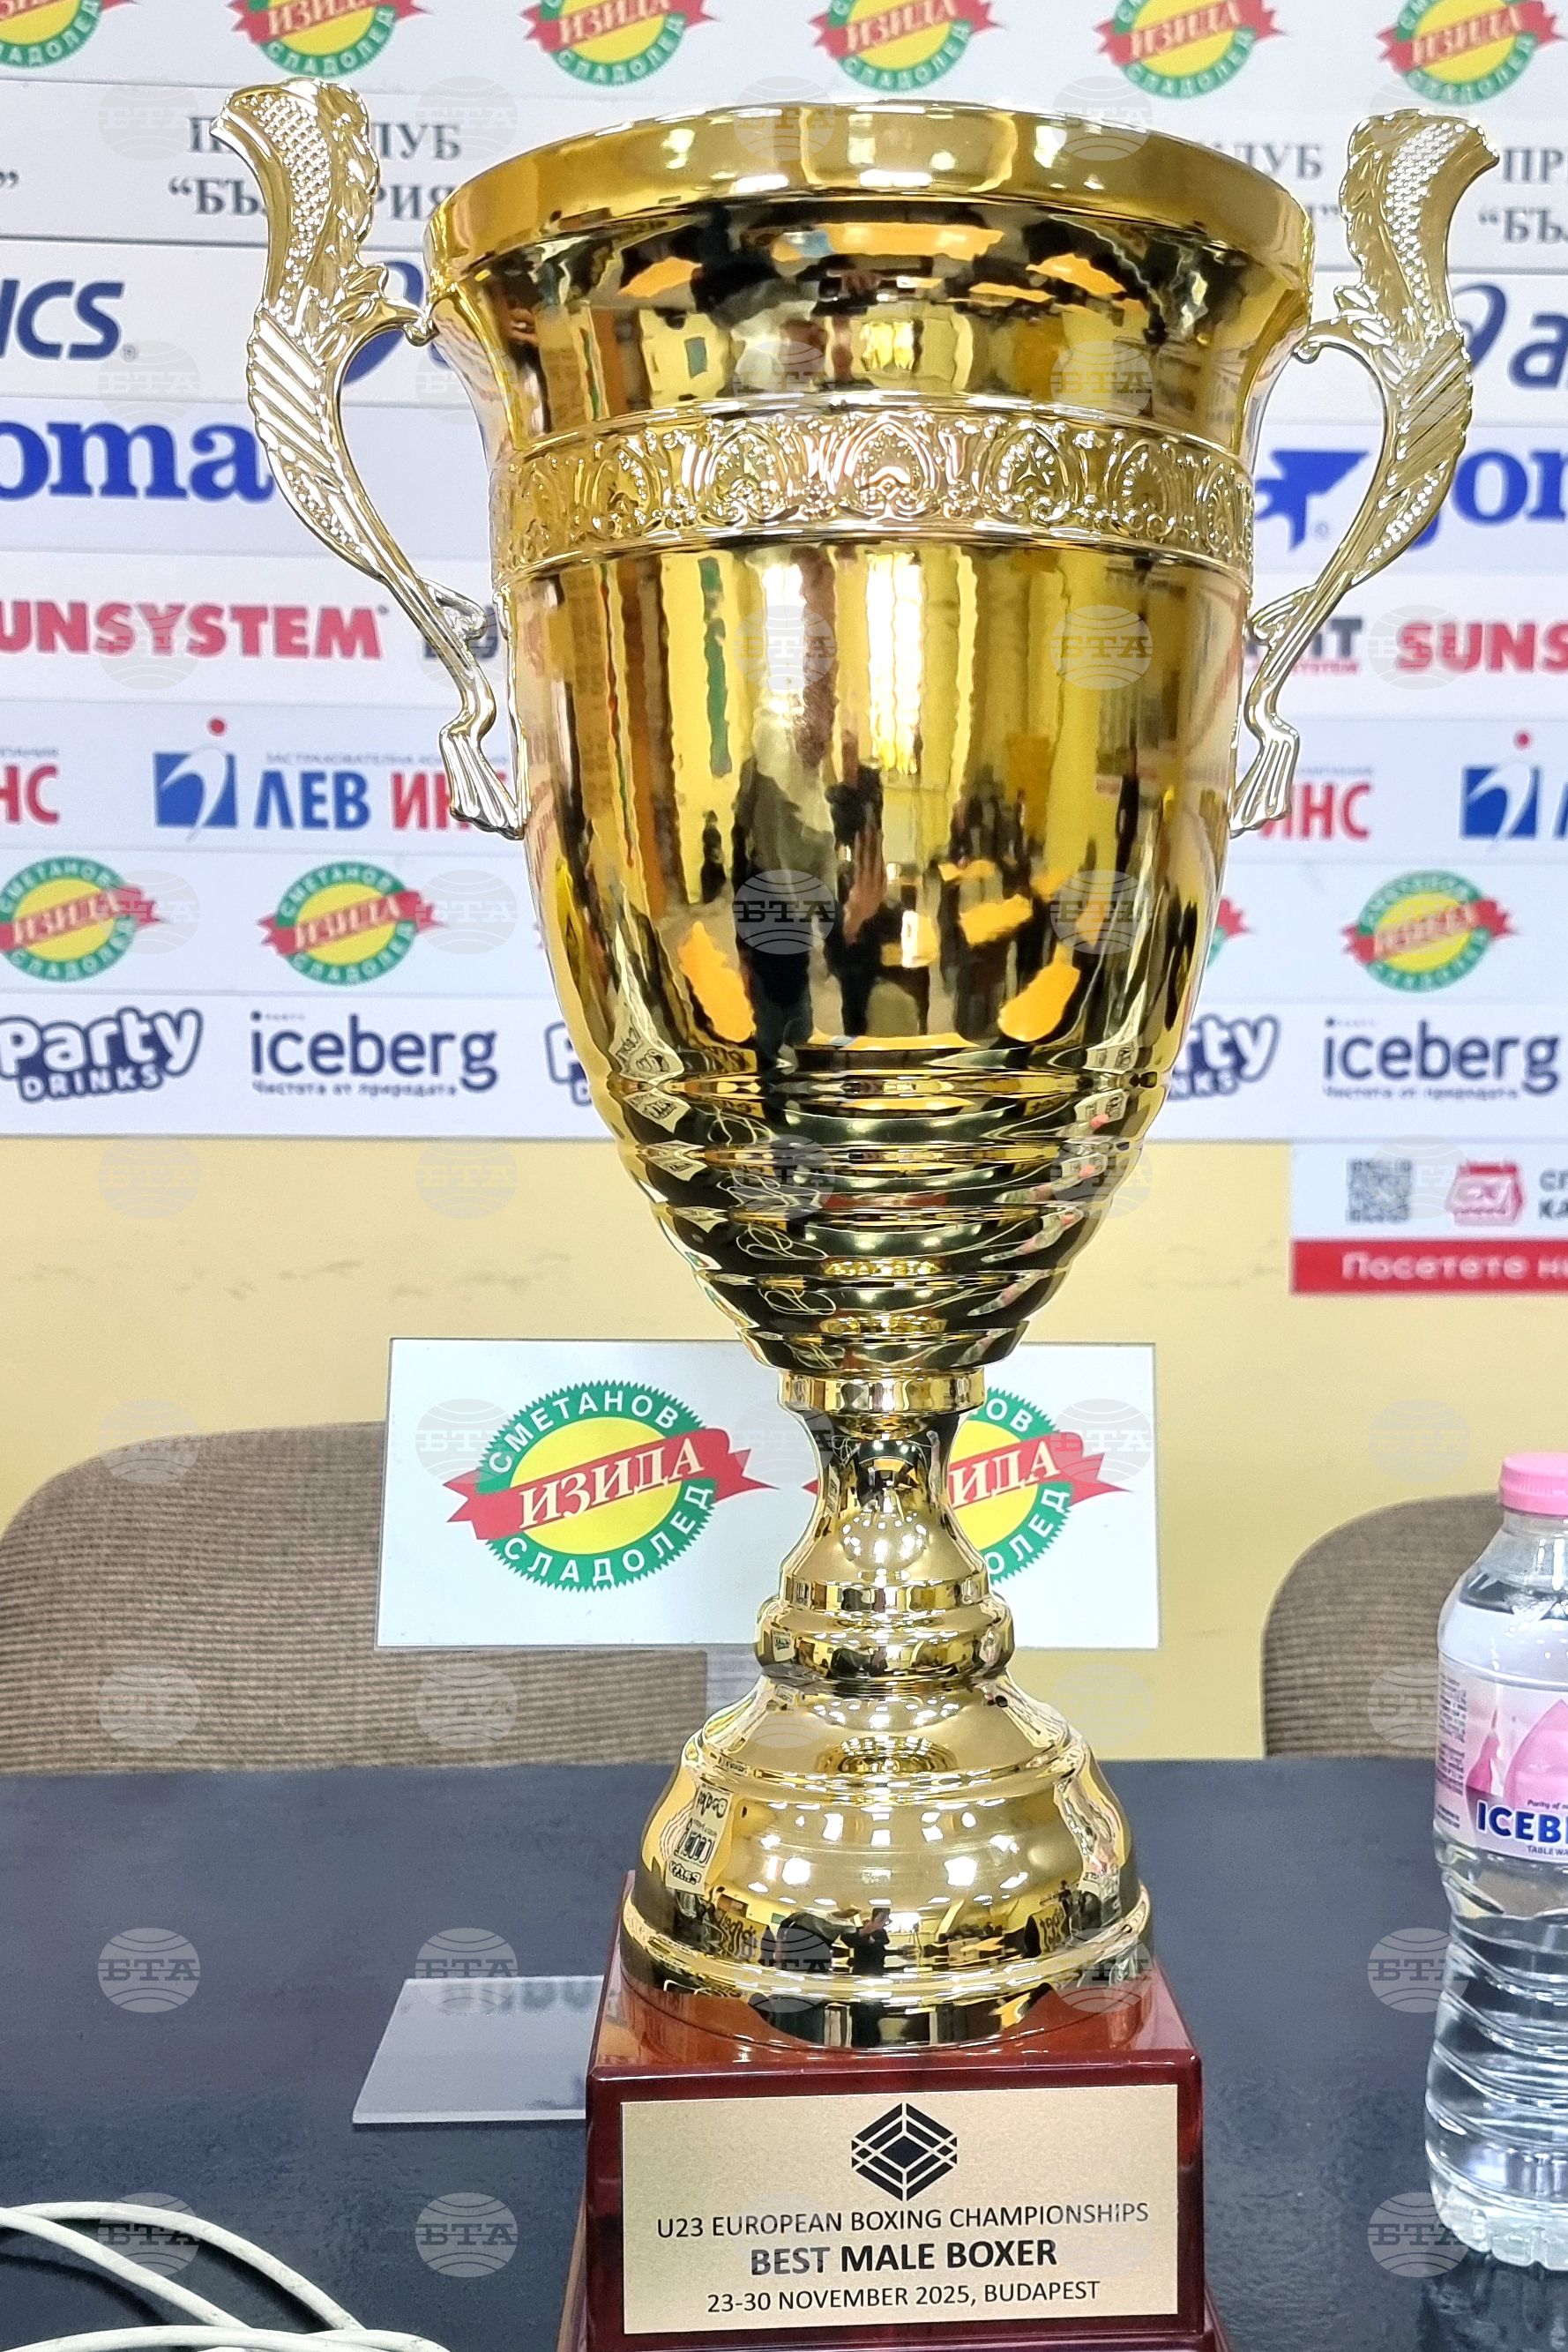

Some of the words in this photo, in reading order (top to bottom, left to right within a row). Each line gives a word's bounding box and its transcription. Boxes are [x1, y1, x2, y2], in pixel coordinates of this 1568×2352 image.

[371, 121, 461, 161] ЛУБ
[253, 770, 371, 830] ЛЕВ
[0, 1006, 204, 1079] Party
[250, 1010, 498, 1092] iceberg
[1324, 1018, 1560, 1095] iceberg
[20, 1064, 163, 1102] DRINKS
[489, 1390, 678, 1474] СМЕТАНОВ
[519, 1437, 706, 1531] ИЗИДА
[949, 1440, 1062, 1509] ИДА
[504, 1484, 713, 1587] СЛАДОЛЕД
[984, 1488, 1071, 1576] ОЛЕД
[1476, 1801, 1568, 1845] ICEB
[657, 2217, 704, 2239] U23
[712, 2212, 842, 2236] EUROPEAN
[850, 2208, 942, 2232] BOXING
[949, 2202, 1149, 2229] CHAMPIONSHIPS
[750, 2246, 831, 2276] BEST
[840, 2243, 935, 2274] MALE
[946, 2238, 1057, 2269] BOXER
[706, 2293, 772, 2314] 23-30
[779, 2288, 909, 2311] NOVEMBER
[915, 2285, 977, 2310] 2025,
[983, 2280, 1101, 2303] BUDAPEST
